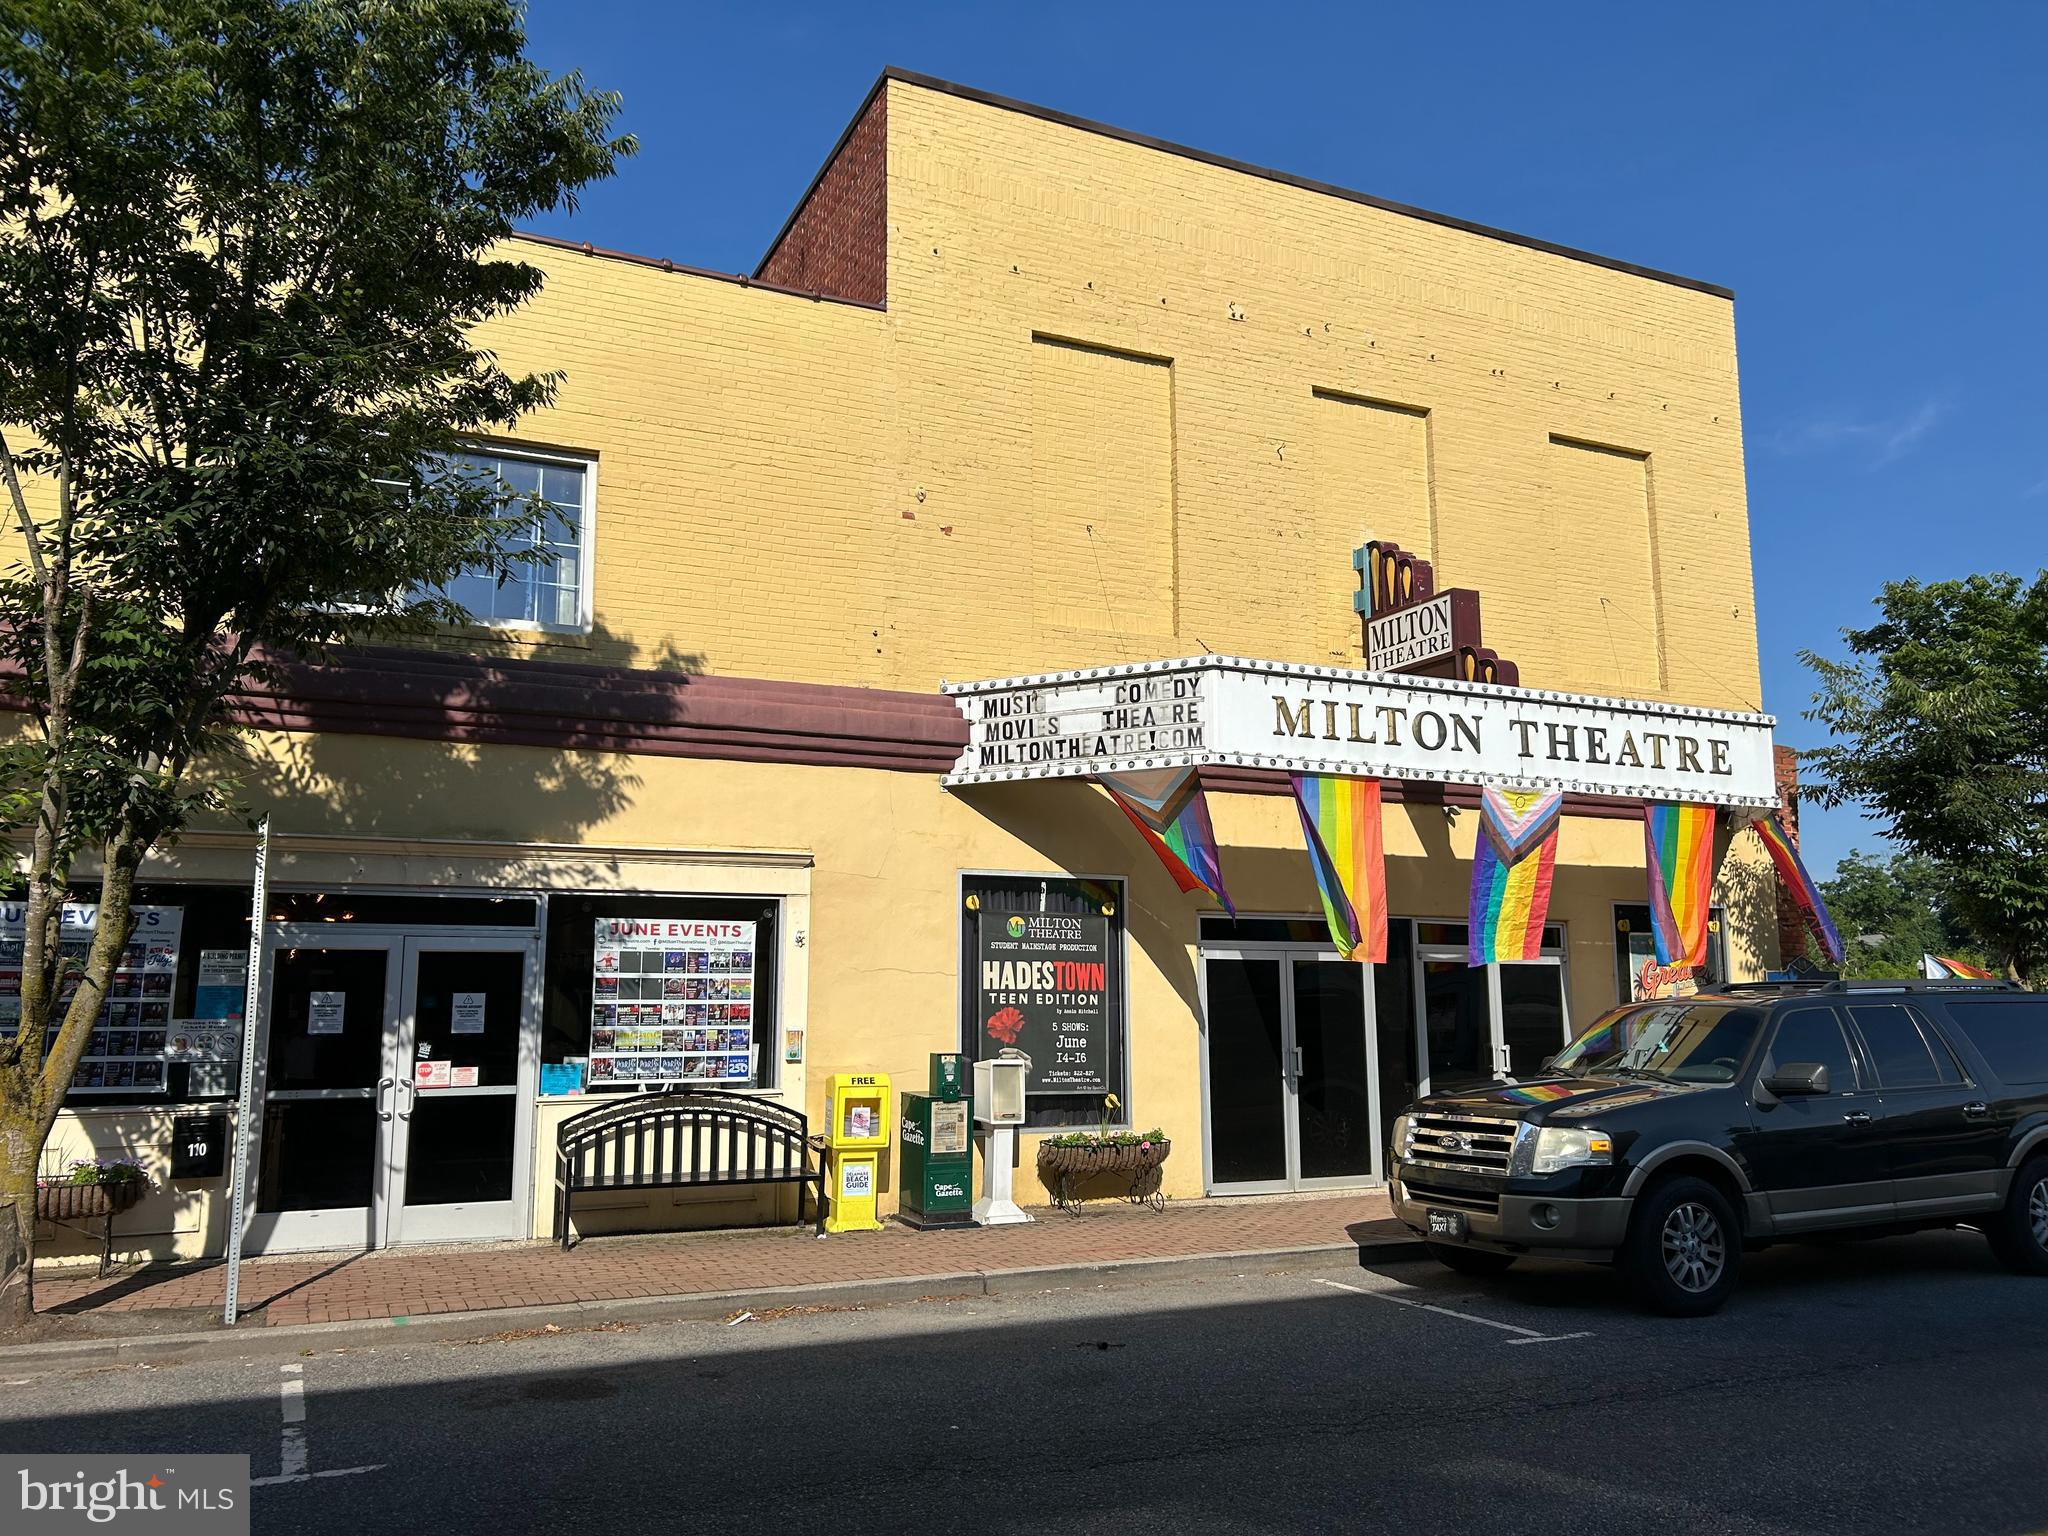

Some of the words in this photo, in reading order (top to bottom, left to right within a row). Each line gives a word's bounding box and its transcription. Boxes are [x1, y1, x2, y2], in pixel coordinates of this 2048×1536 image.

[1371, 600, 1449, 652] MILTON
[1372, 632, 1450, 671] THEATRE
[1116, 677, 1201, 704] COMEDY
[985, 717, 1059, 742] MOVIES
[1102, 702, 1198, 730] THEATRE
[1272, 695, 1483, 755] MILTON
[1510, 719, 1733, 776] THEATRE
[1028, 917, 1082, 929] MILTON
[610, 923, 661, 936] JUNE
[668, 924, 742, 938] EVENTS
[1028, 929, 1082, 939] THEATRE
[990, 942, 1019, 950] STUDENT
[1022, 943, 1057, 951] MAINSTAGE
[147, 954, 173, 967] July
[983, 961, 1104, 991] HADESTOWN
[989, 993, 1028, 1005] TEEN
[1036, 993, 1099, 1006] EDITION
[1052, 1022, 1058, 1031] 5
[1061, 1022, 1089, 1031] SHOWS:
[1056, 1035, 1087, 1048] June
[1056, 1053, 1087, 1063] 14-16
[728, 1062, 748, 1074] 250
[851, 1077, 876, 1085] FREE
[902, 1116, 915, 1132] Cape
[902, 1129, 924, 1146] Gazette
[1440, 1138, 1456, 1147] Ford
[187, 1142, 207, 1157] 110
[934, 1183, 952, 1192] Cape
[935, 1189, 963, 1197] Gazette
[1431, 1223, 1447, 1232] TAXI
